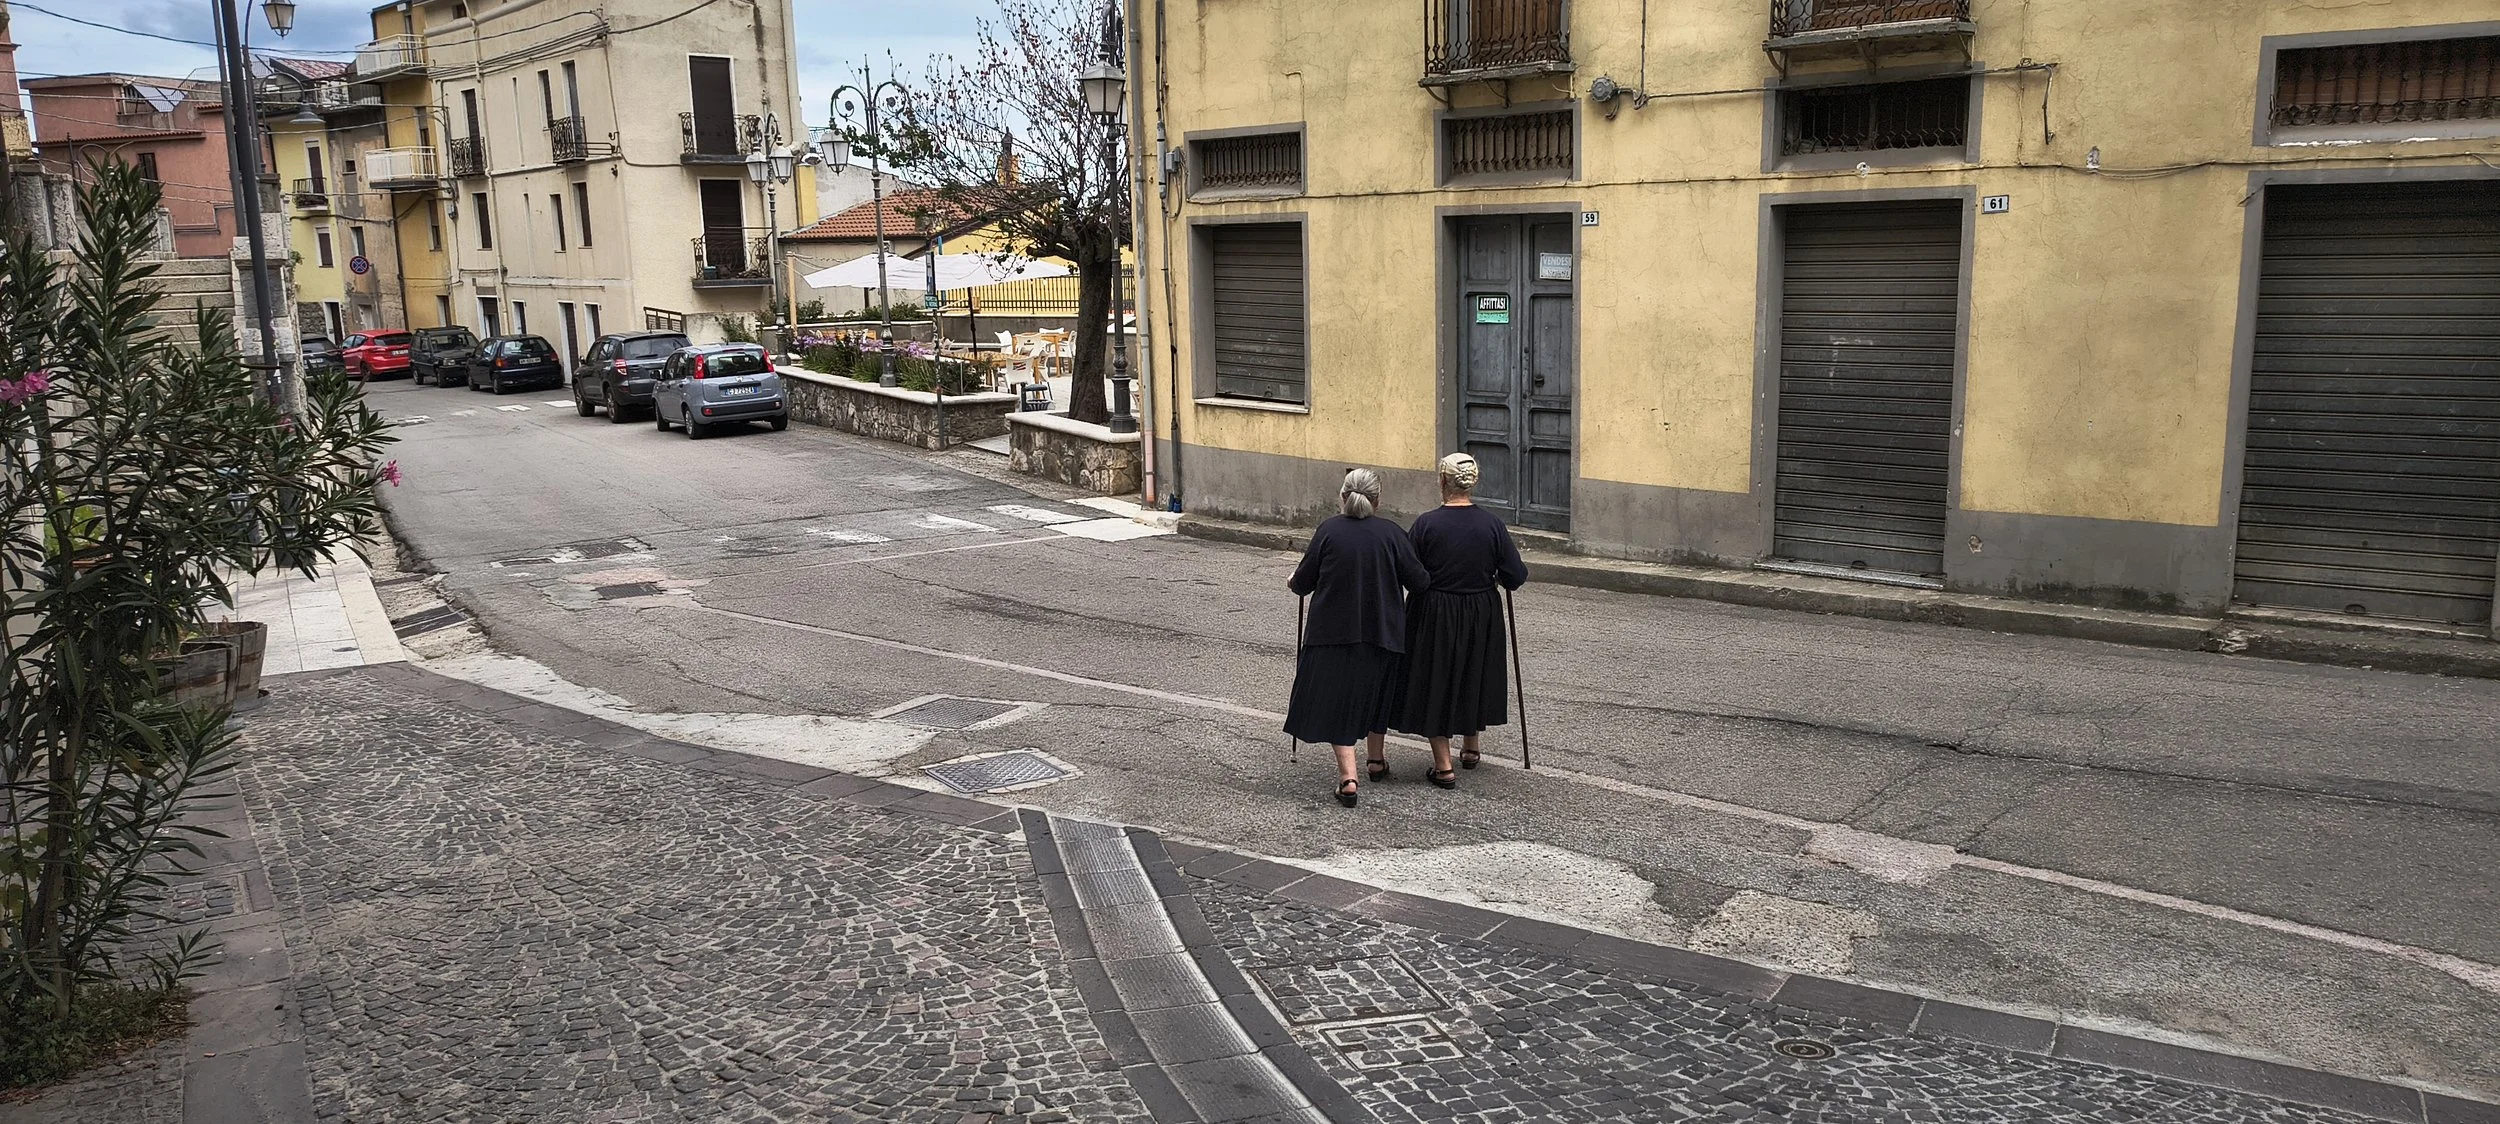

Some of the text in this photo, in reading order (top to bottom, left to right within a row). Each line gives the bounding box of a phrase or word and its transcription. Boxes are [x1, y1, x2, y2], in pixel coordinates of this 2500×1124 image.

[1990, 198, 2002, 209] 61
[1585, 213, 1595, 223] 59
[1480, 297, 1506, 310] AFFITTASI
